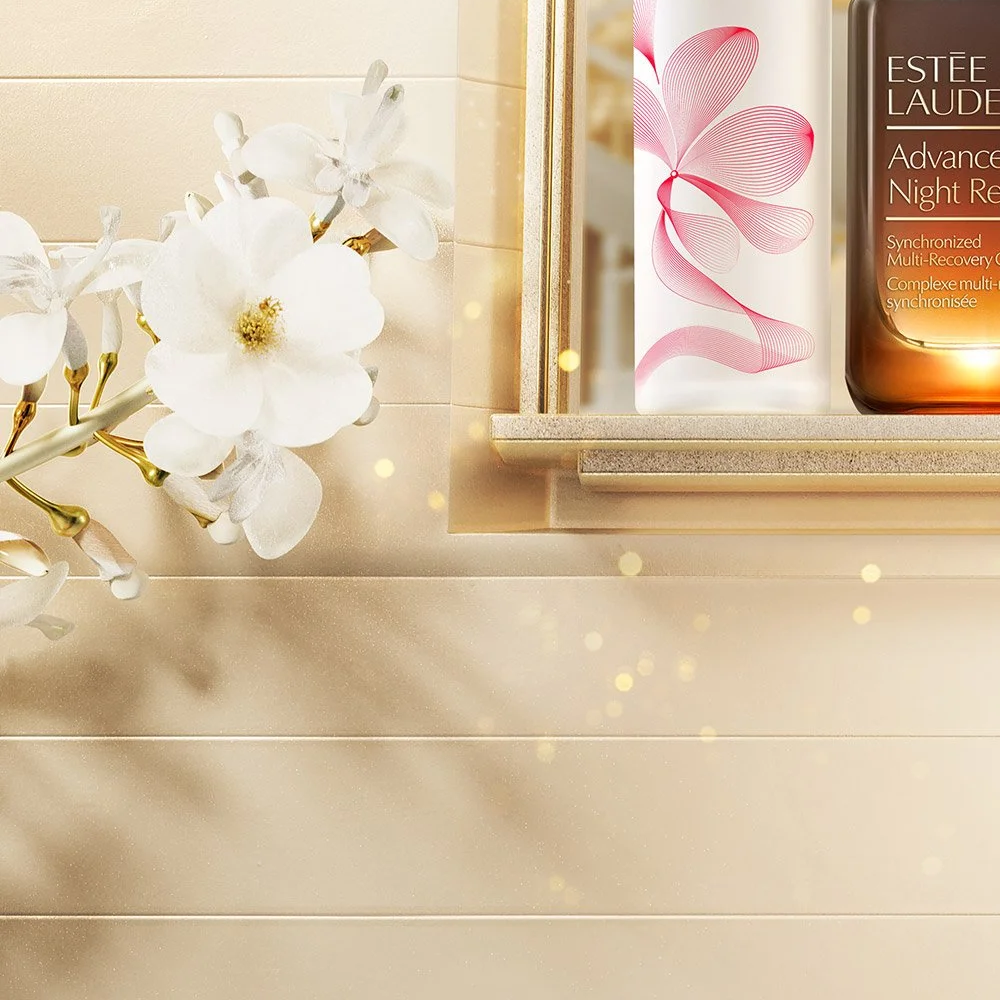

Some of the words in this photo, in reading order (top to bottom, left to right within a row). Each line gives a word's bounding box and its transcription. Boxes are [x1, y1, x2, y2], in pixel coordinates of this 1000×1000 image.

[889, 177, 960, 212] Night
[887, 234, 982, 252] Synchronized
[887, 253, 991, 269] Multi-Recovery
[886, 276, 957, 291] Complexe
[886, 295, 977, 312] synchronisée
